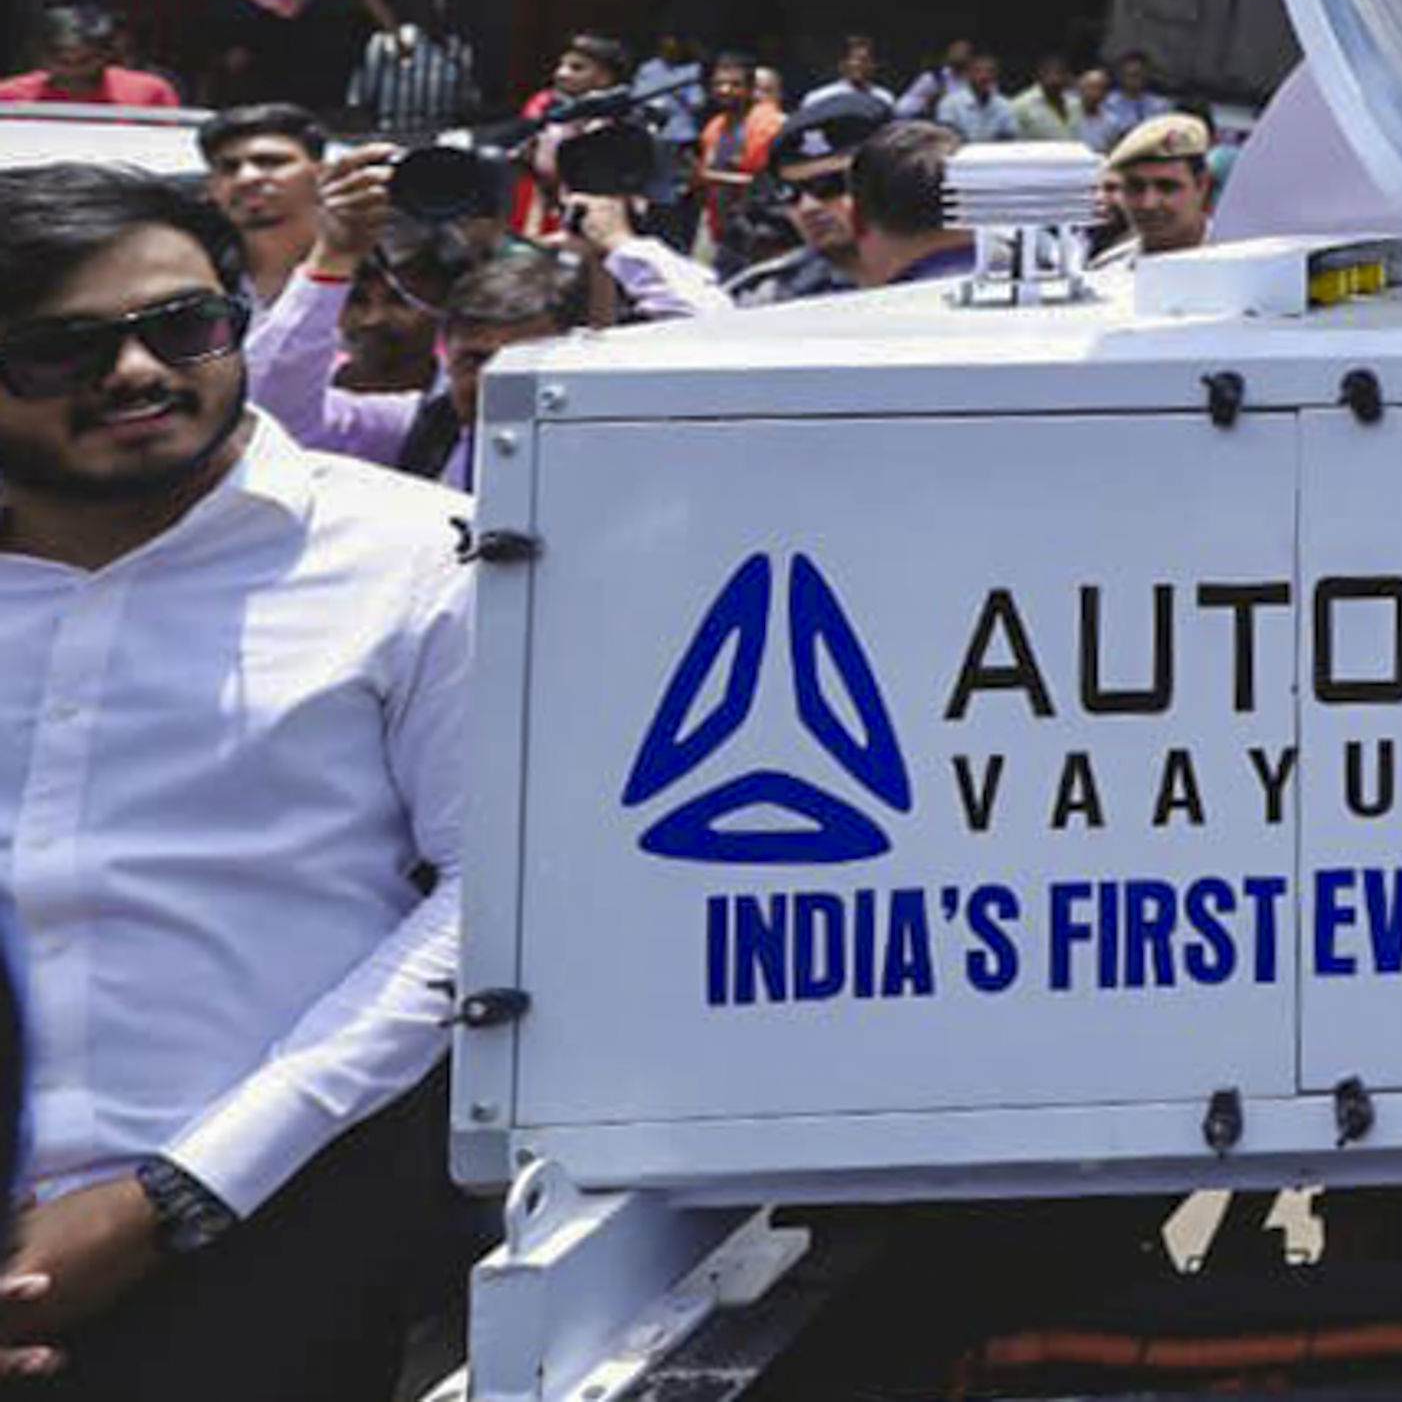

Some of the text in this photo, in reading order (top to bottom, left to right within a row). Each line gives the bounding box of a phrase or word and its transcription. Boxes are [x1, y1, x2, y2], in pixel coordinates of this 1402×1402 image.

[952, 739, 1396, 832] VAAYU
[705, 885, 1020, 1007] INDIA'S
[1048, 875, 1288, 990] FIRST
